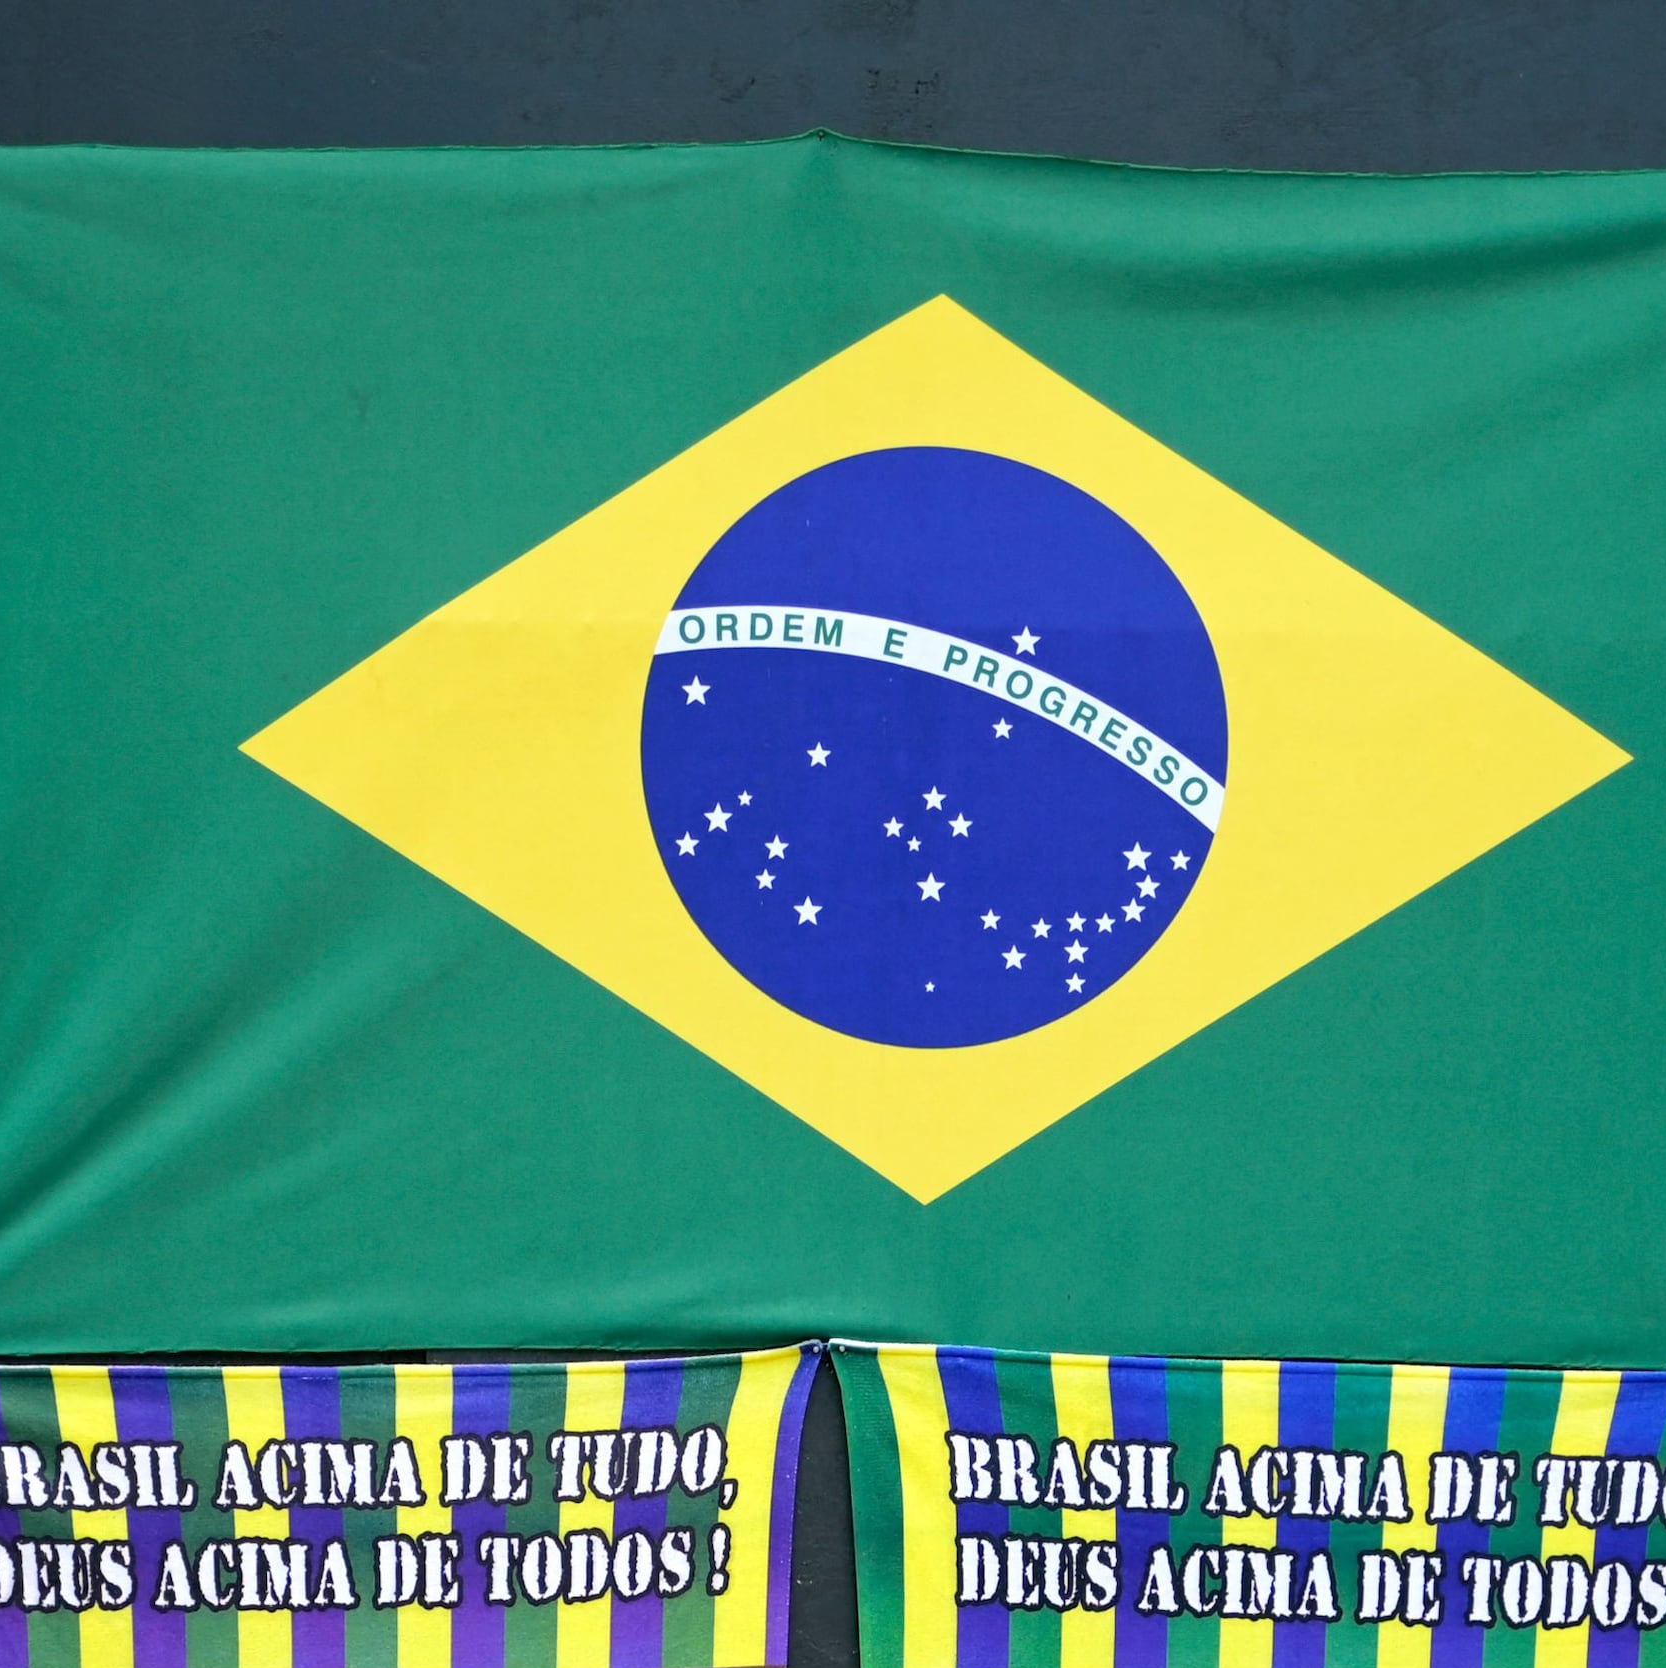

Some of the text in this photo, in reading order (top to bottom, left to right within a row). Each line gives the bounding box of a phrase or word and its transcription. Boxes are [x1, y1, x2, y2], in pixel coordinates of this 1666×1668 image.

[679, 613, 1209, 806] ORDEM E PROGRESSO
[214, 1439, 423, 1508] ACIMA
[442, 1434, 530, 1505] DE
[548, 1425, 735, 1507] TUDO,
[947, 1432, 1186, 1511] BRASIL
[1204, 1447, 1410, 1521] ACIMA
[1428, 1454, 1517, 1524] DE
[153, 1539, 357, 1609] ACIMA
[375, 1536, 460, 1607] DE
[478, 1529, 693, 1603] TODOS
[958, 1535, 1120, 1609] DEUS
[1136, 1546, 1339, 1620] ACIMA
[1357, 1552, 1444, 1624] DE
